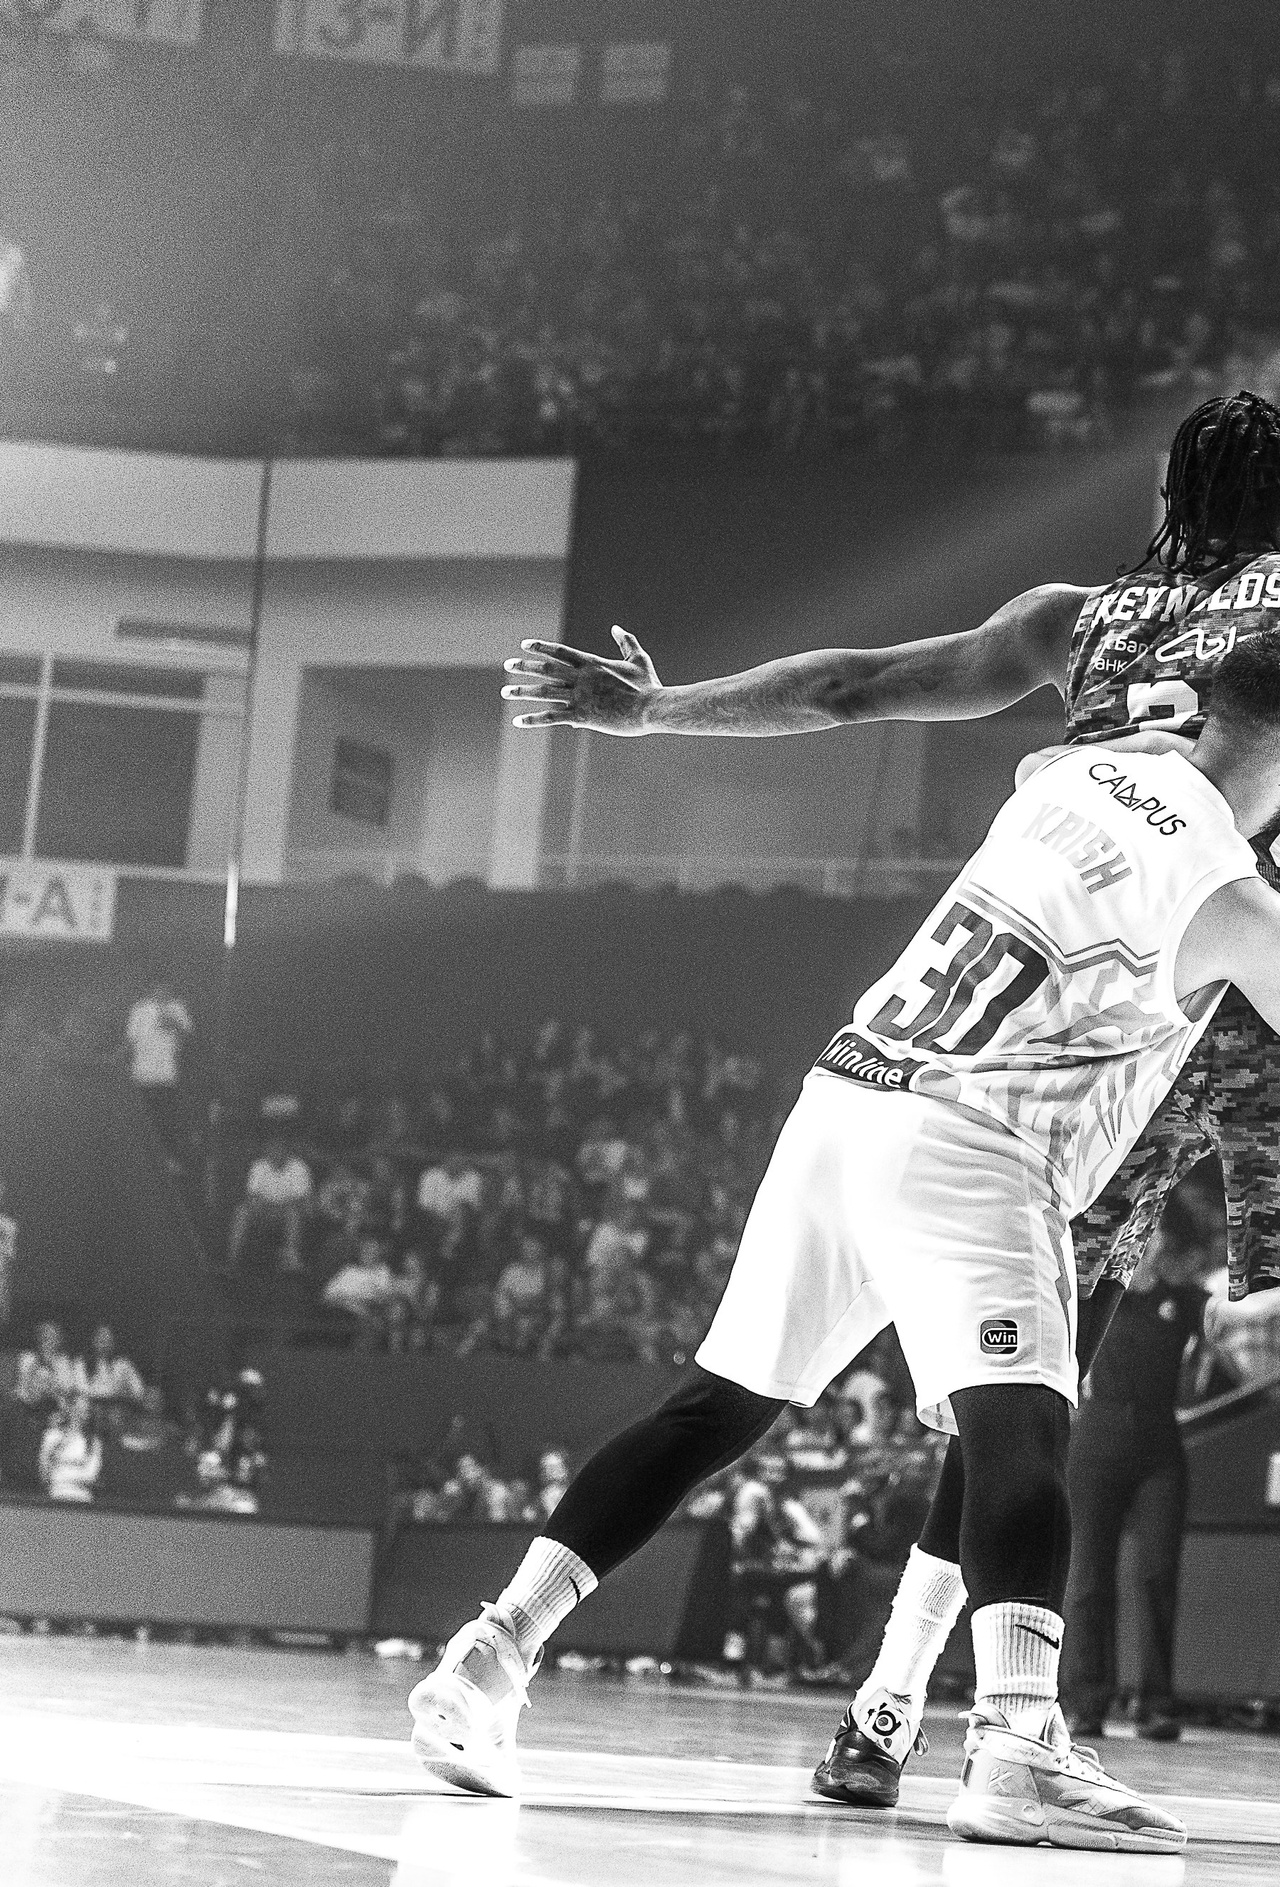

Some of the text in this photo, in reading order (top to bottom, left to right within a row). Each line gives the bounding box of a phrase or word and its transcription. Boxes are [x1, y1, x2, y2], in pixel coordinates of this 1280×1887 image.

[1095, 657, 1128, 673] анк
[1021, 802, 1133, 896] KRISH
[866, 901, 1051, 1056] 30
[821, 1038, 905, 1089] Winline
[987, 1331, 1016, 1343] Win
